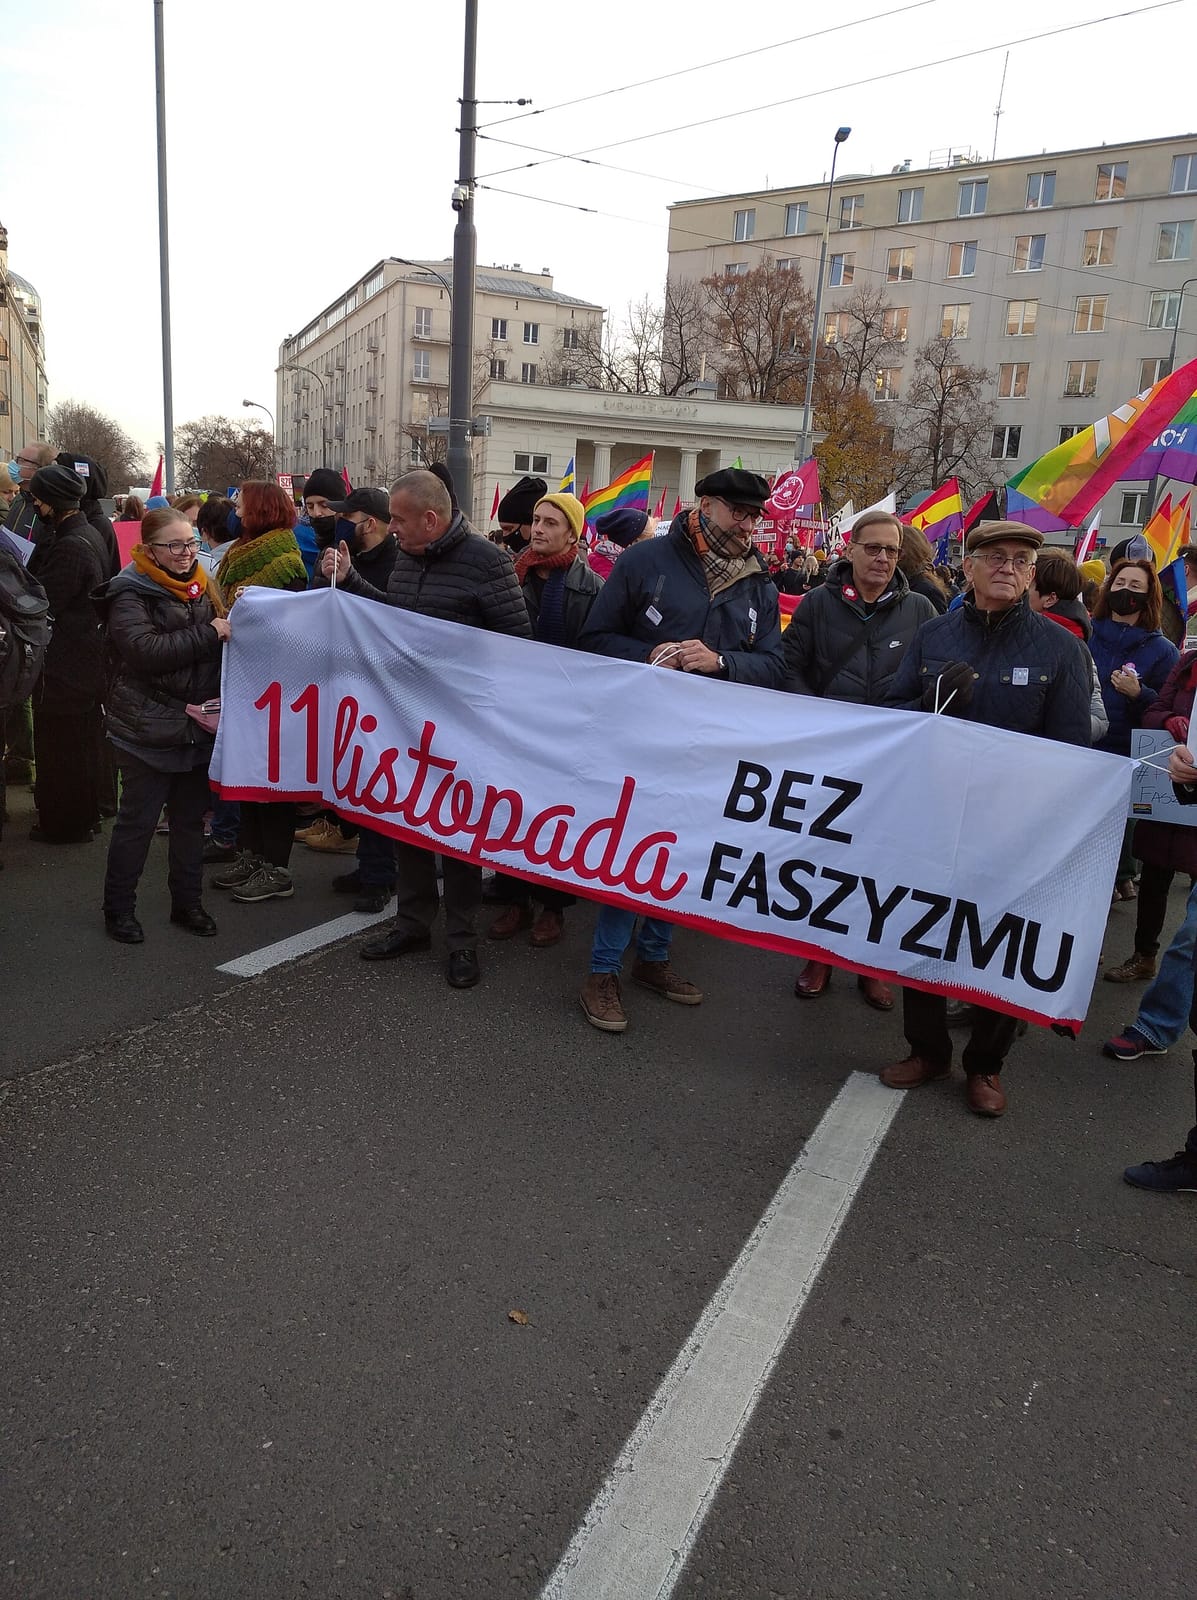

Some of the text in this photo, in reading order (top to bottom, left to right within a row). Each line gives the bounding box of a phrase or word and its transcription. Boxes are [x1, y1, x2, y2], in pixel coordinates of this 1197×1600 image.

[254, 681, 688, 901] 11 listopada
[723, 759, 863, 844] BEZ
[700, 841, 1074, 993] FASZYZMU
